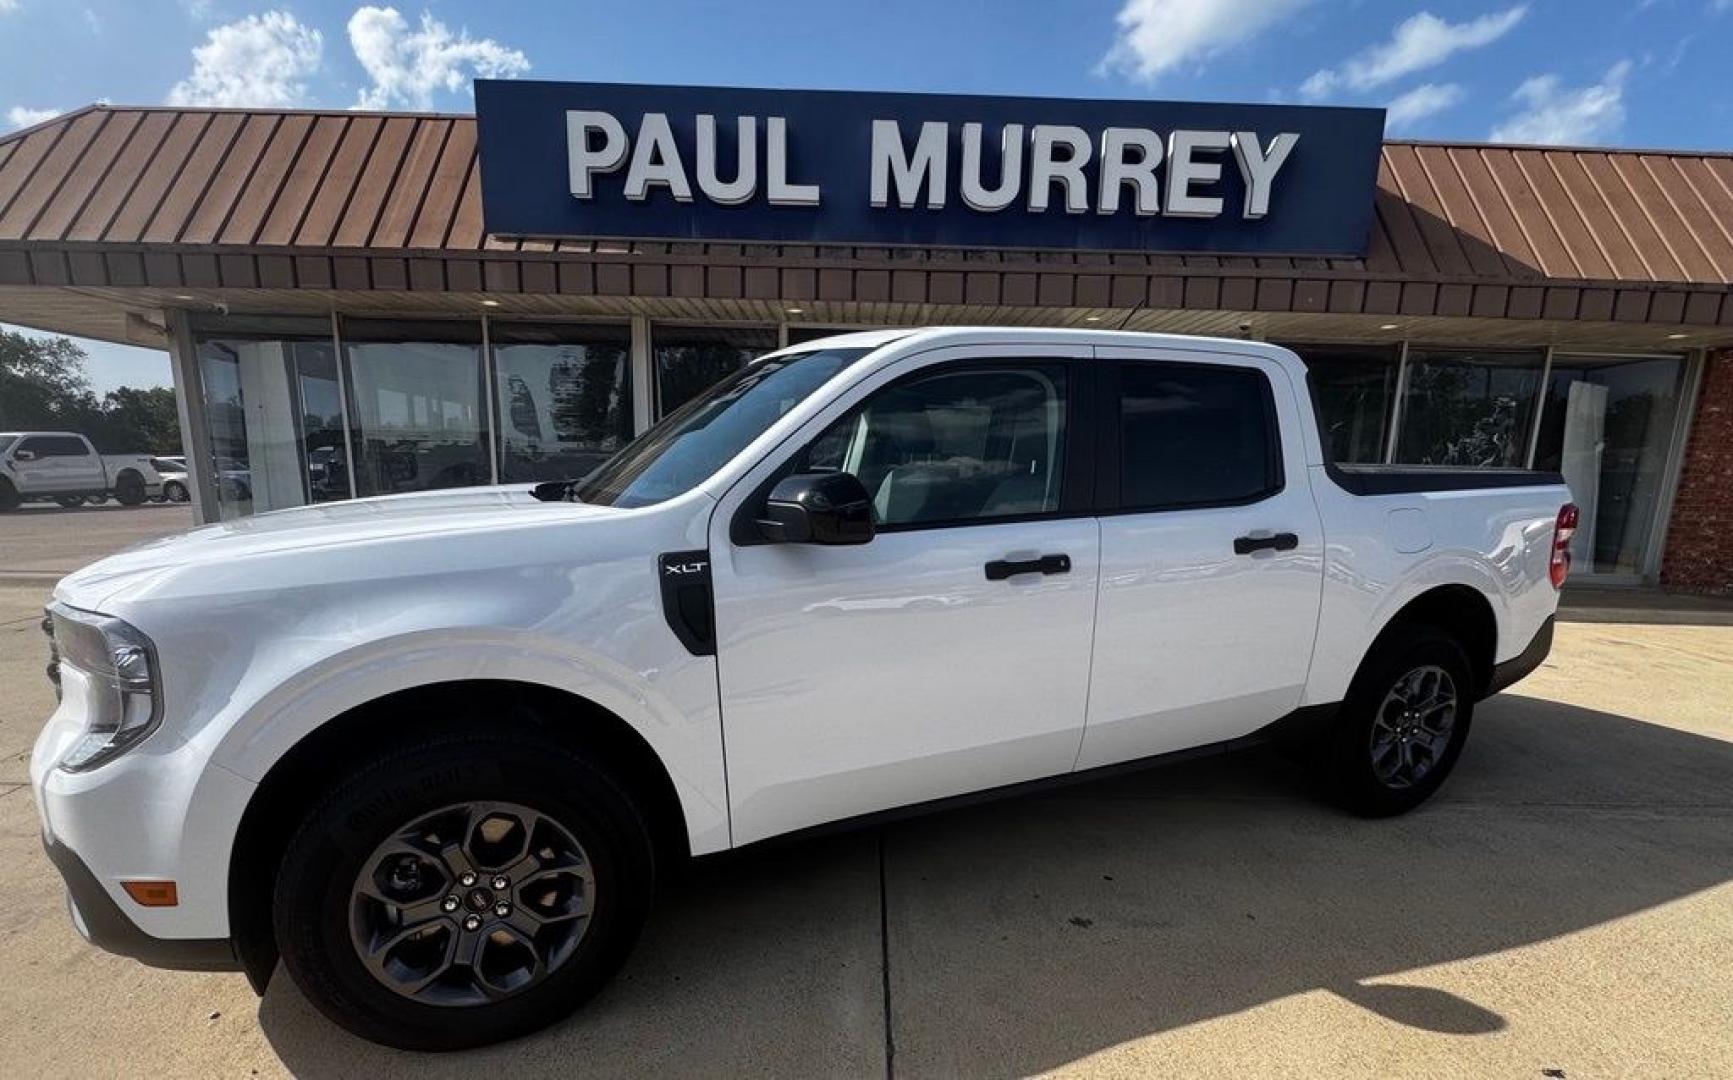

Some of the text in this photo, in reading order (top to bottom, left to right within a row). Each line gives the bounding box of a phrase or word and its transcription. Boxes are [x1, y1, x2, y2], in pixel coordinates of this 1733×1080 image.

[565, 109, 1300, 220] PAUL MURREY
[665, 561, 708, 575] XLT
